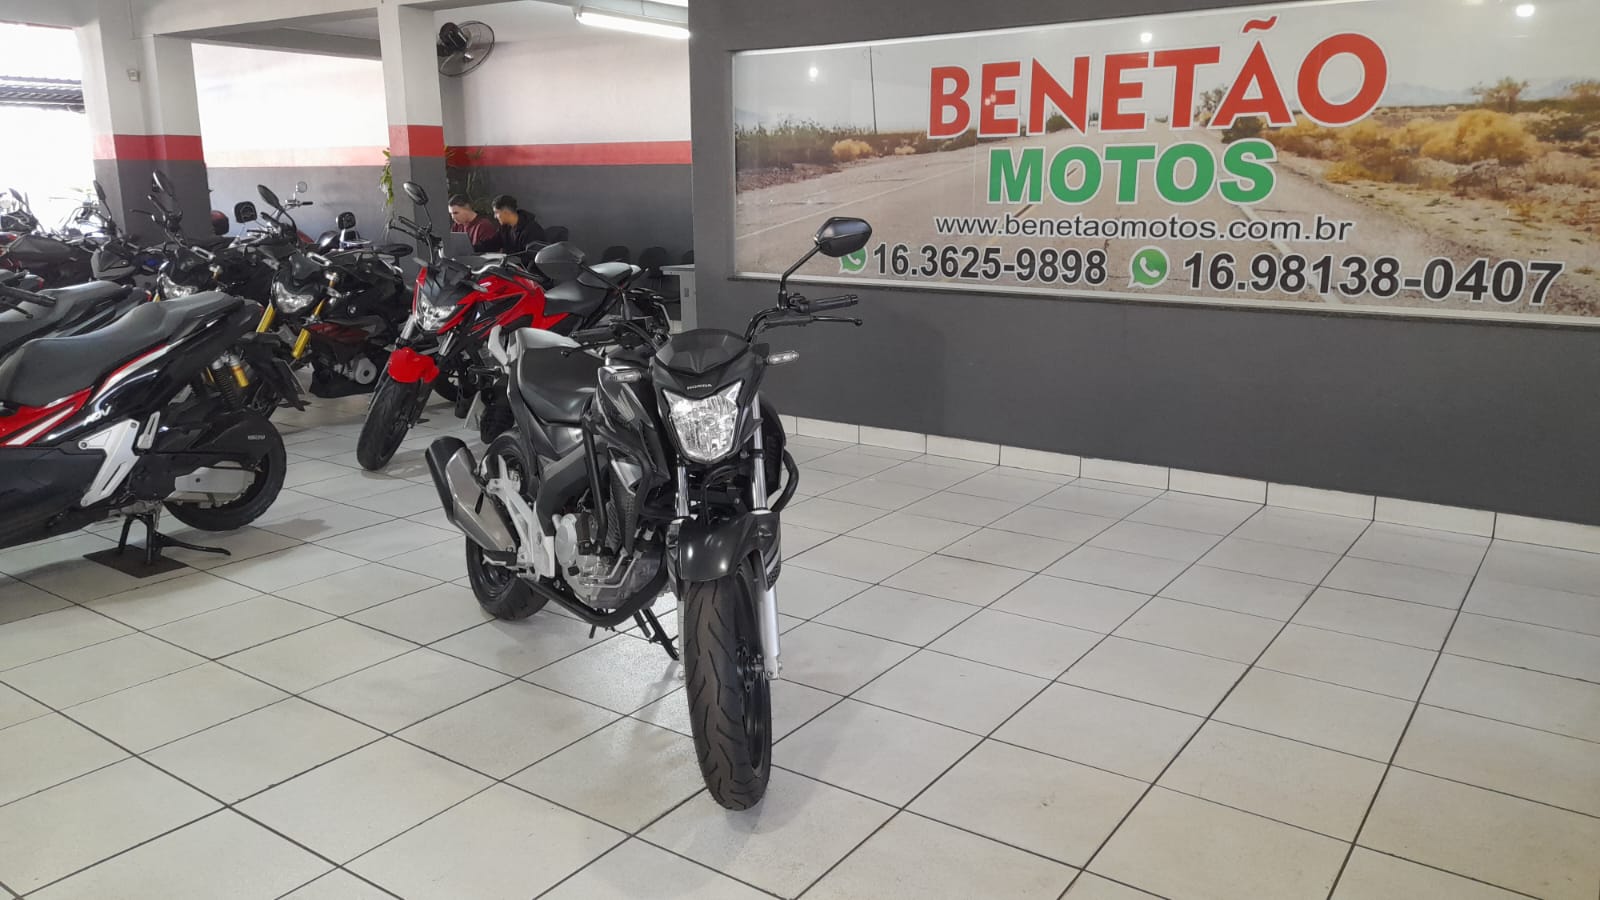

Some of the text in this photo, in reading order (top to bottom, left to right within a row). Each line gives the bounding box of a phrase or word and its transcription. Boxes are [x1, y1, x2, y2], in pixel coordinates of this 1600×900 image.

[927, 15, 1388, 140] BENETÃO
[988, 139, 1277, 206] MOTOS
[935, 214, 1354, 242] www.benetaomotos.com.br
[873, 243, 1564, 304] 16.3625-9898 16.98138-0407
